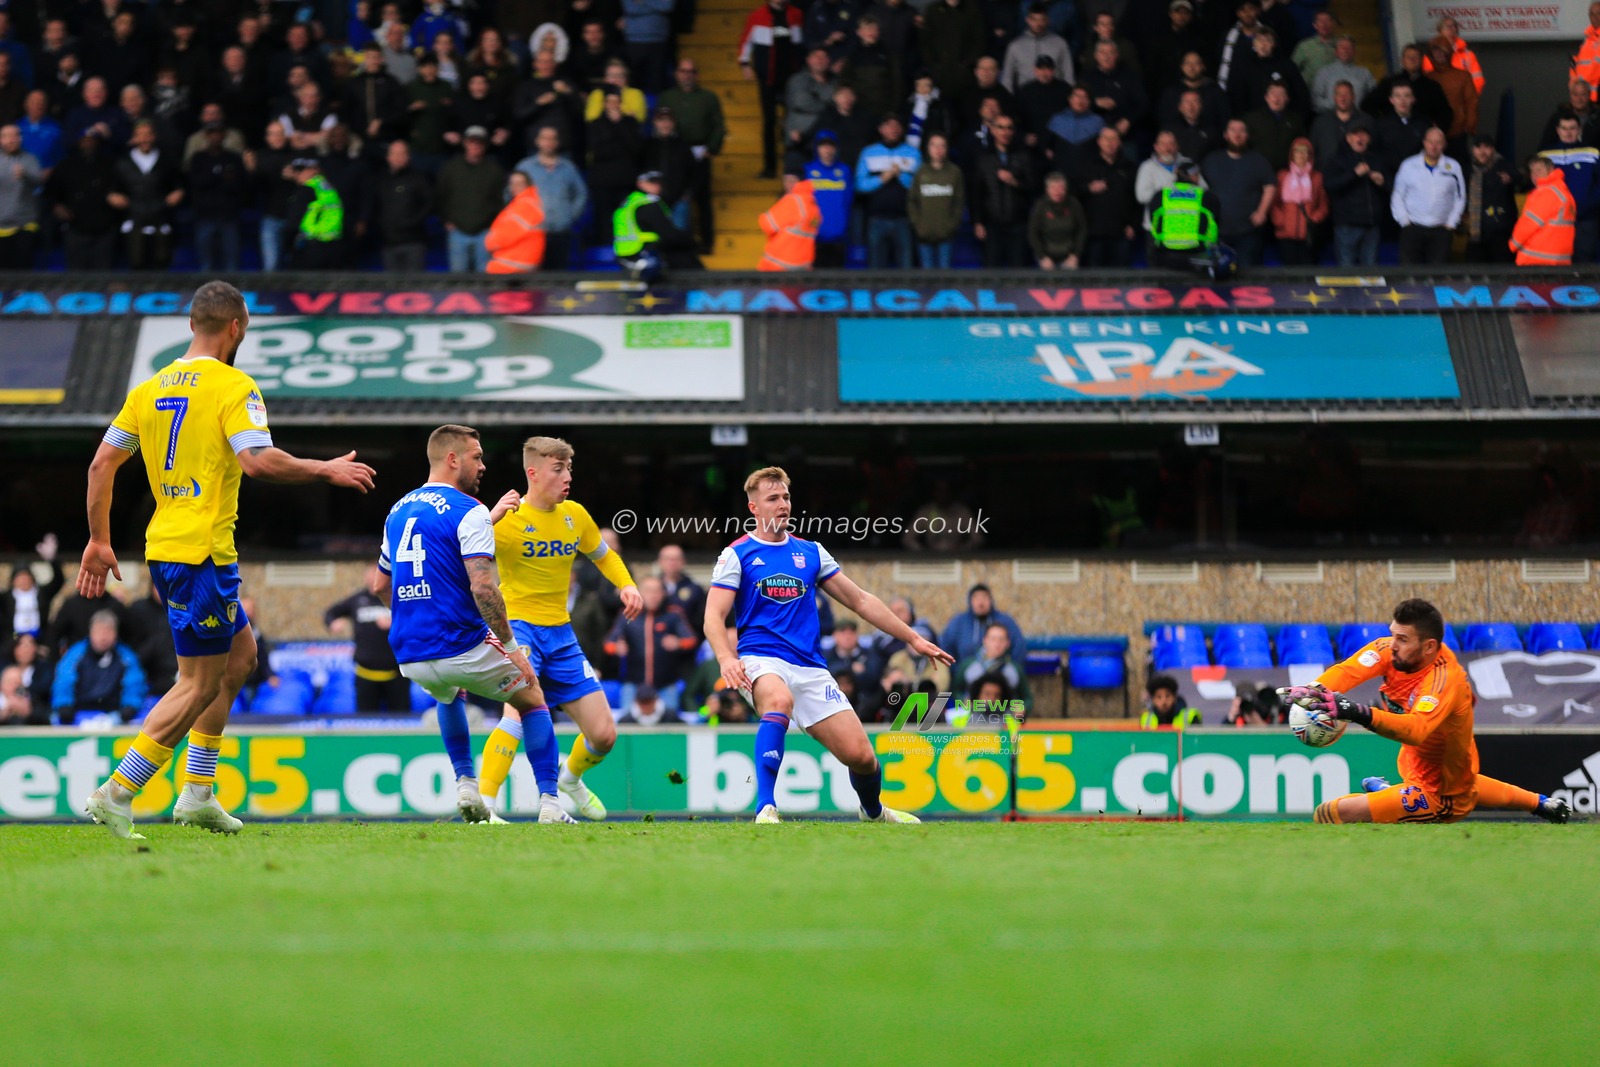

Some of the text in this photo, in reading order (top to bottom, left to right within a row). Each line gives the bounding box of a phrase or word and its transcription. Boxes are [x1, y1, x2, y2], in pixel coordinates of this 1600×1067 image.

[0, 291, 535, 315] AGICL VEGAS
[686, 286, 1275, 312] MAGICAL VEGAS
[968, 319, 1310, 338] GREENE KING
[240, 321, 497, 362] pop
[1034, 337, 1266, 384] IPA
[155, 396, 189, 470] 7
[394, 492, 451, 515] CHAMBERS
[395, 517, 426, 578] 4
[397, 579, 431, 598] each
[766, 578, 798, 587] MAGICAL
[767, 587, 799, 597] VEGAS
[687, 732, 1350, 814] bet365.com
